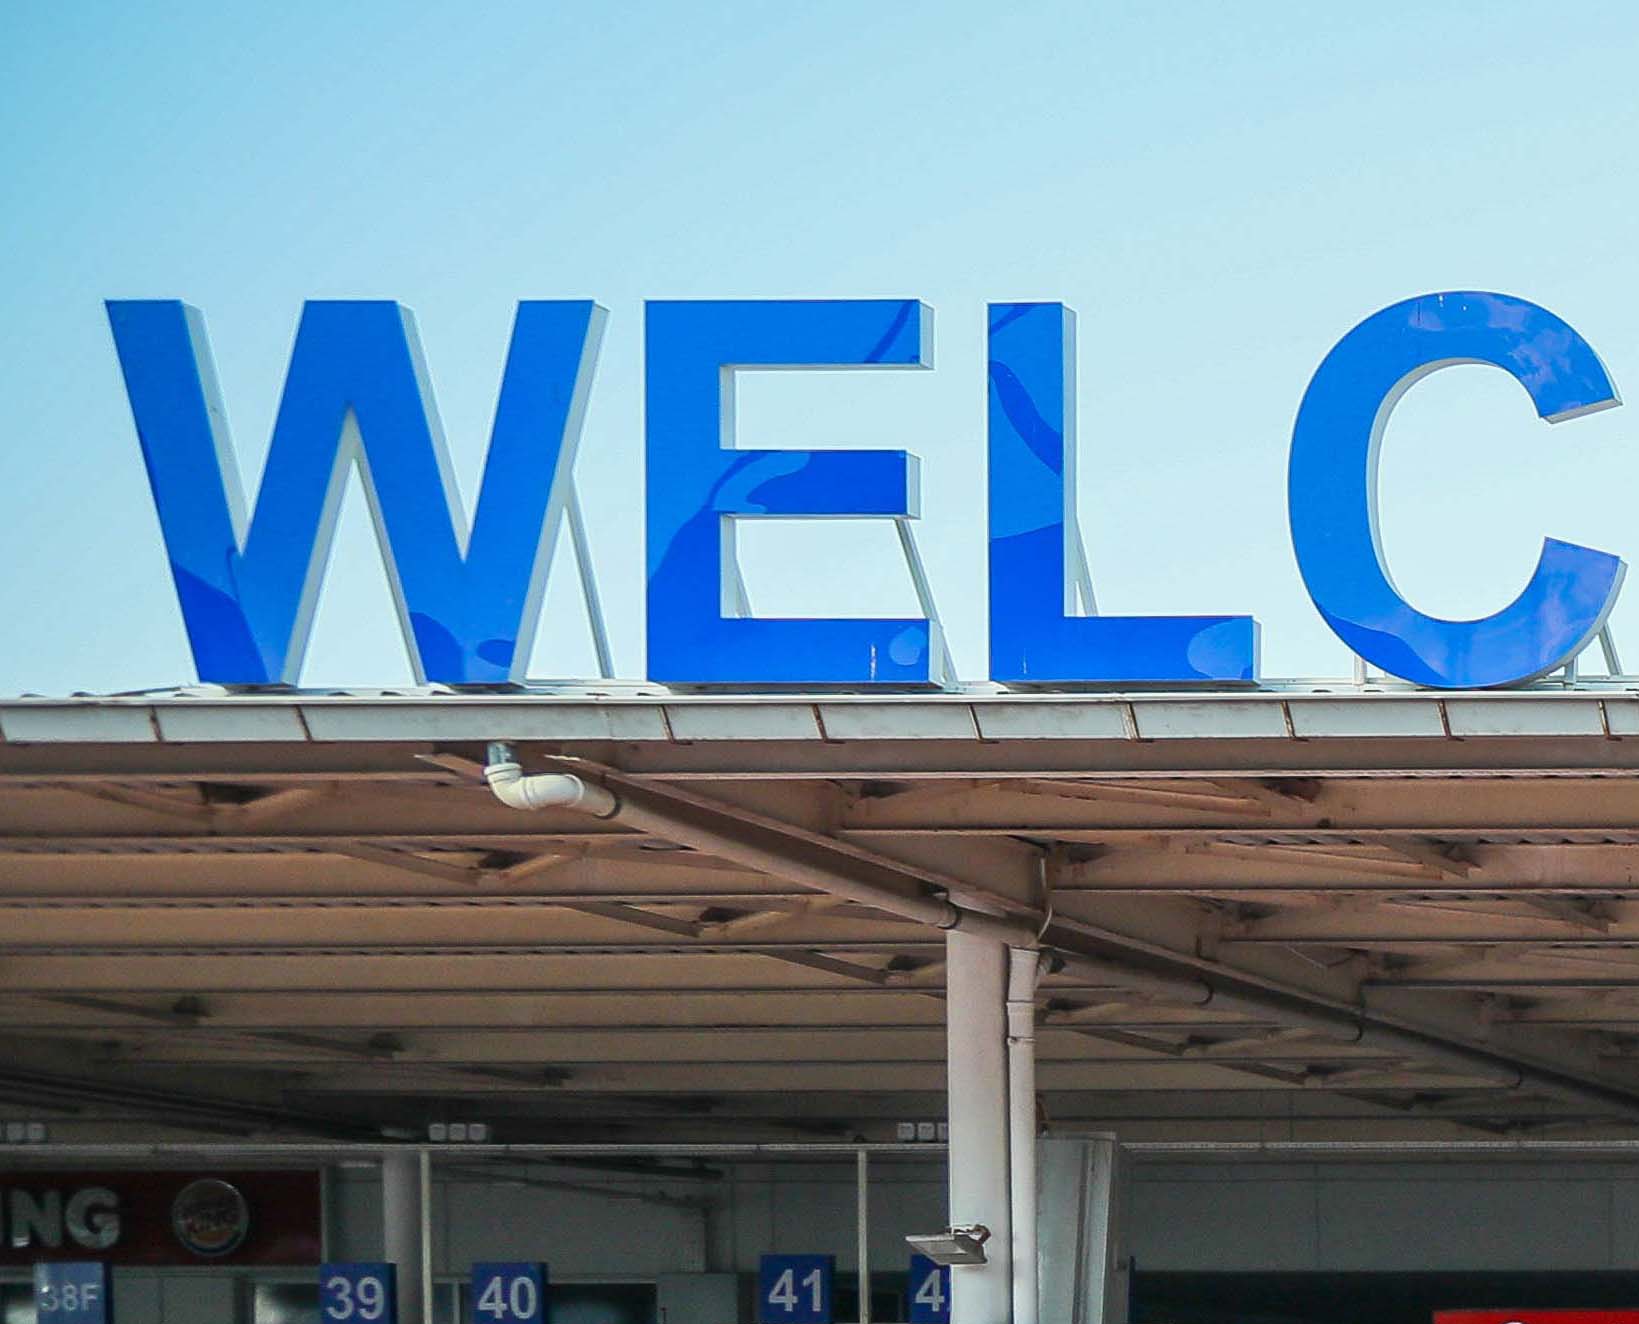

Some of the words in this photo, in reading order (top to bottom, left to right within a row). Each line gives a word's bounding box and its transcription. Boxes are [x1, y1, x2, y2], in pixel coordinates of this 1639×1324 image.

[39, 1283, 100, 1313] 38F
[326, 1276, 385, 1320] 39
[477, 1276, 537, 1320] 40
[768, 1268, 822, 1312] 41
[915, 1268, 949, 1312] 4
